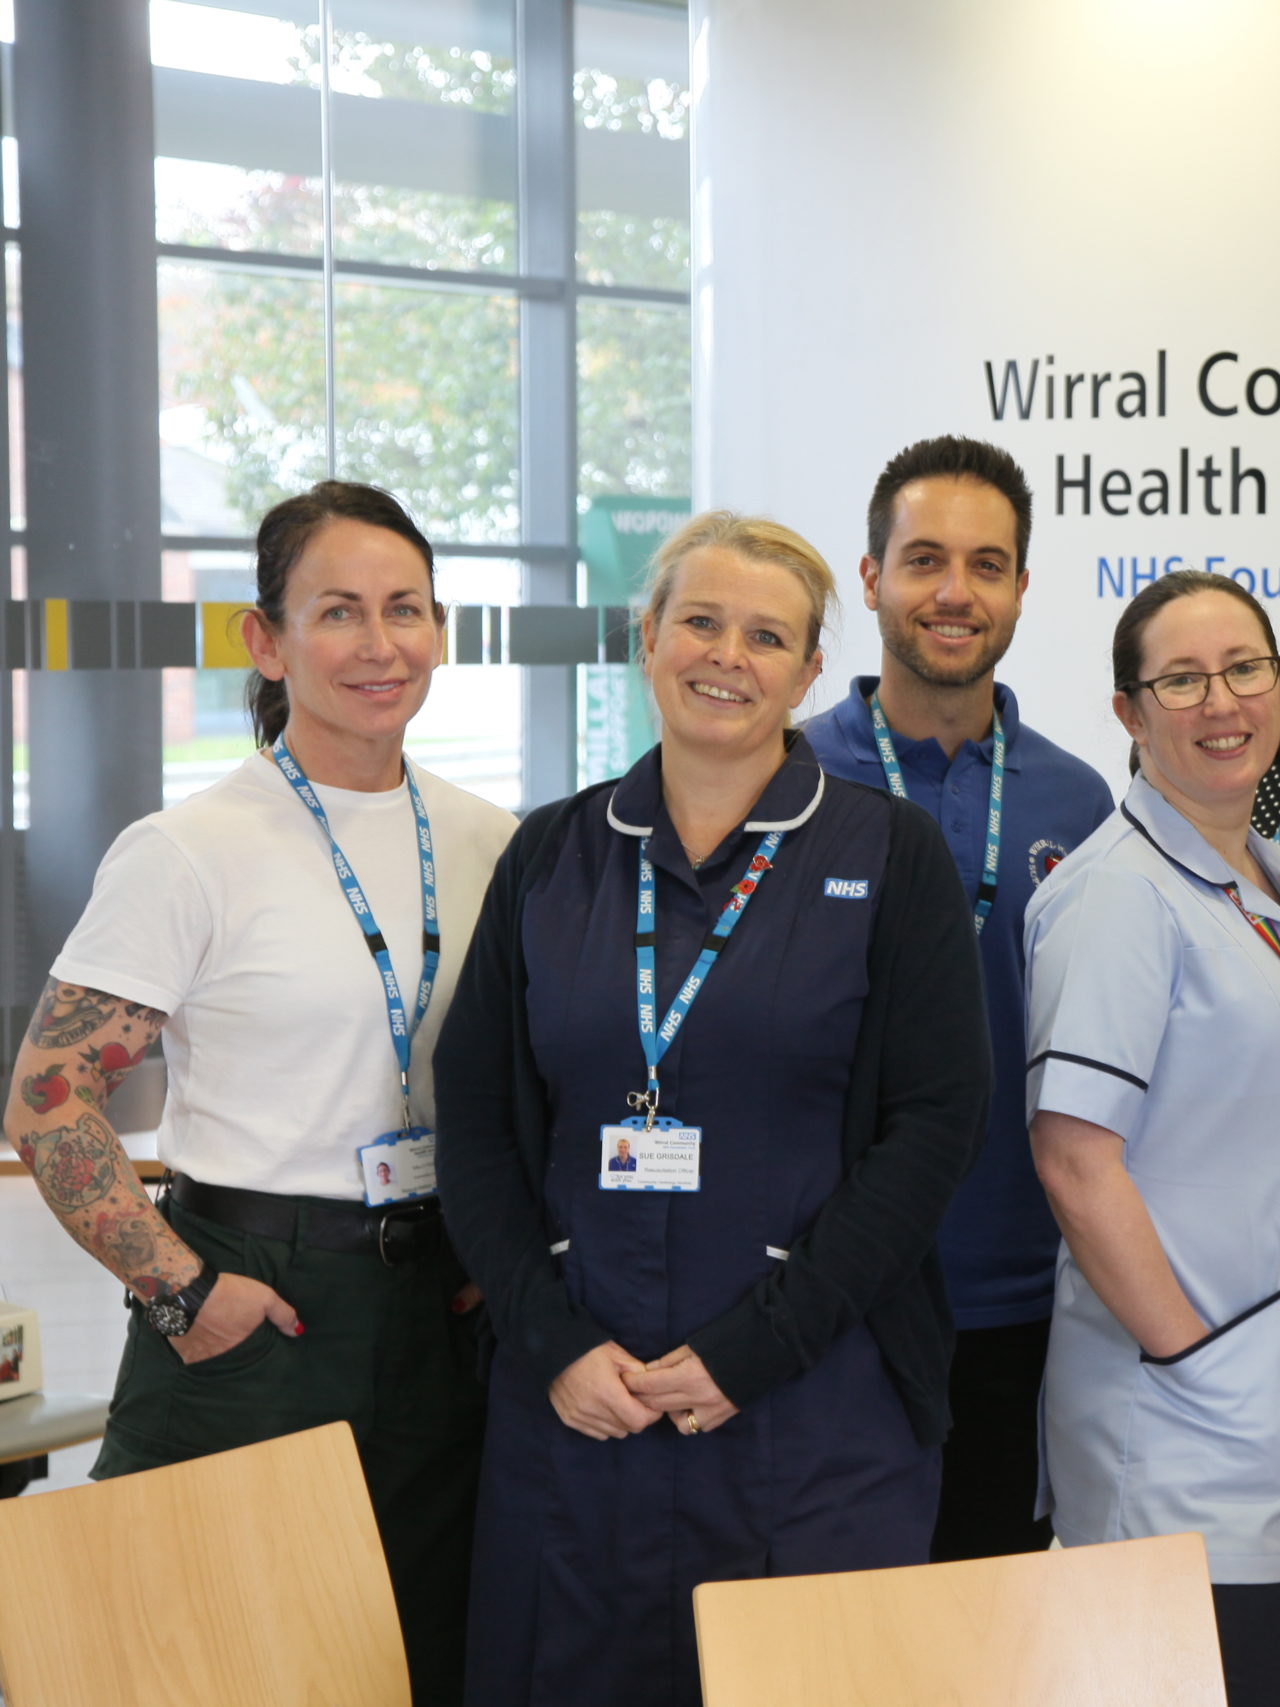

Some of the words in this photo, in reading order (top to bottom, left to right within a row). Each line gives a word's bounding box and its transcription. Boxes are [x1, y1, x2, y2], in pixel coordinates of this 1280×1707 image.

[984, 350, 1169, 421] Wirral
[1054, 446, 1267, 516] Health
[873, 708, 885, 729] NHS
[878, 738, 895, 763] NHS
[995, 741, 1004, 768] NHS
[278, 756, 301, 780] NHS
[297, 785, 320, 809] NHS
[992, 775, 1002, 801] NHS
[414, 796, 427, 819] NHS
[989, 809, 1000, 836] NHS
[419, 828, 431, 853] NHS
[334, 852, 351, 879] NHS
[986, 844, 998, 872] NHS
[423, 861, 434, 887] NHS
[347, 887, 369, 915] NHS
[827, 881, 866, 896] NHS
[426, 896, 436, 920] NHS
[640, 890, 652, 914] NHS
[384, 971, 399, 999] NHS
[418, 981, 431, 1008] NHS
[640, 969, 653, 995] NHS
[679, 976, 701, 1004] NHS
[391, 1009, 405, 1036] NHS
[640, 1004, 653, 1033] NHS
[660, 1010, 682, 1042] NHS
[656, 1153, 693, 1161] GRISDALE
